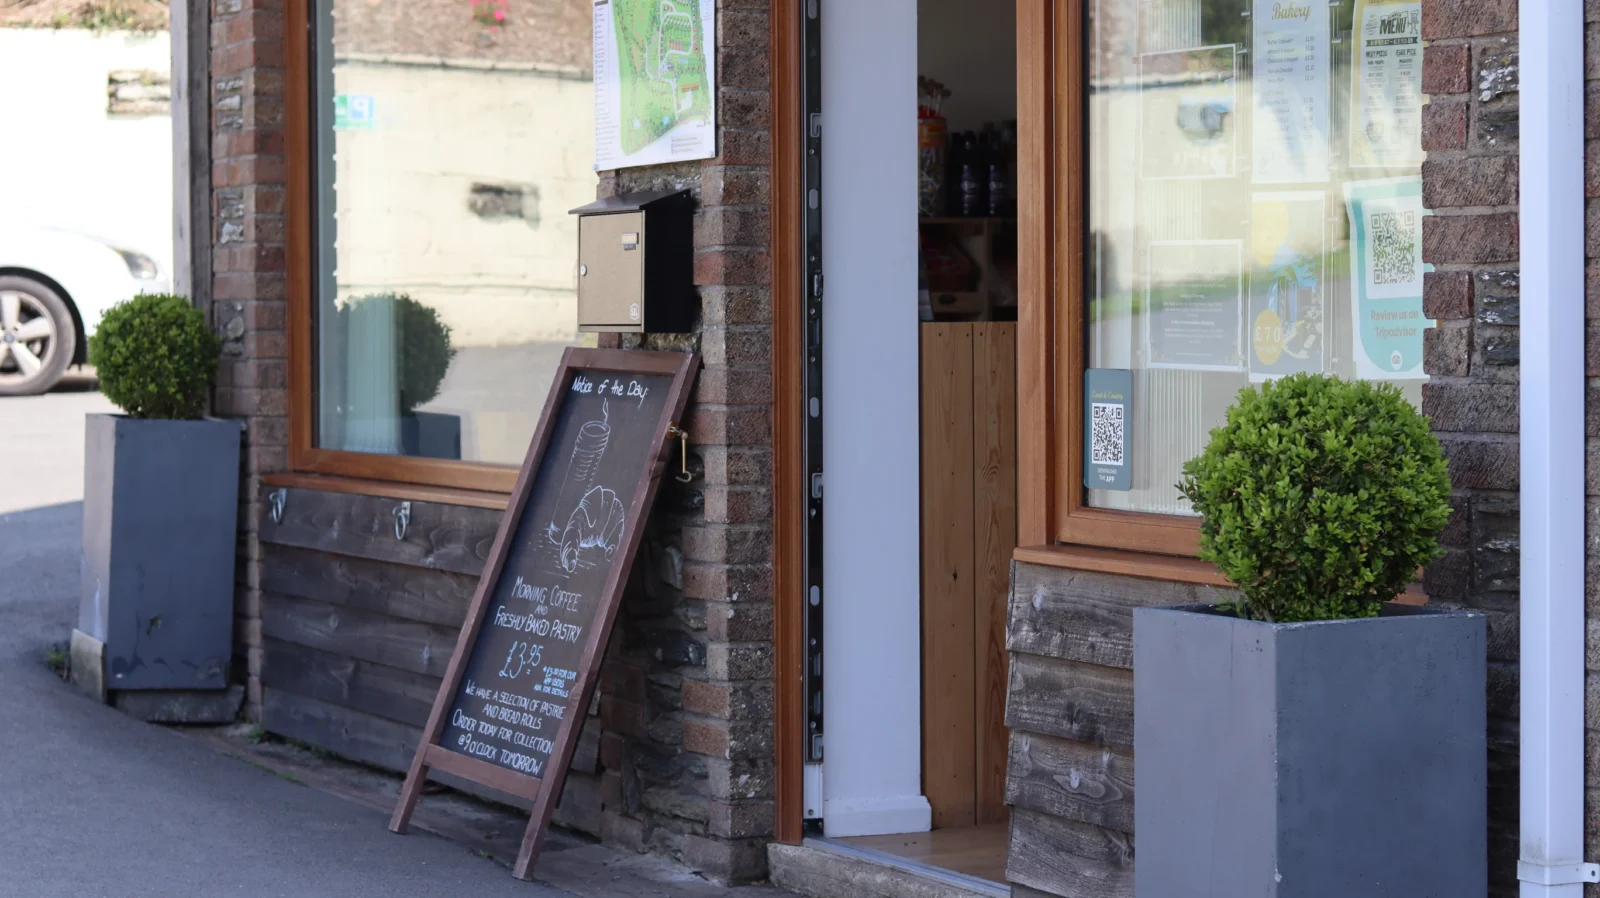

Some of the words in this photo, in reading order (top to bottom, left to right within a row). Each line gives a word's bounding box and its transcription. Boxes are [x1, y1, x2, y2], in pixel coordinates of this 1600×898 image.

[1272, 2, 1311, 23] Bakery
[1379, 17, 1407, 35] MENU
[1370, 309, 1397, 320] Review
[1399, 311, 1407, 320] us
[1408, 310, 1419, 319] on
[1375, 326, 1417, 340] Tripadvisor
[572, 376, 593, 393] Notice
[598, 379, 609, 395] of
[611, 380, 624, 396] the
[1105, 475, 1115, 483] APP
[534, 604, 548, 615] AND
[494, 605, 527, 631] FRESHLY
[525, 614, 550, 636] BAKED
[550, 619, 583, 643] PASTRY
[498, 641, 544, 679] £3.95
[465, 679, 475, 696] WE
[475, 687, 492, 700] HAVE
[492, 690, 498, 703] A
[499, 691, 529, 710] SELECTION
[529, 699, 540, 712] OF
[551, 687, 569, 698] DETAILS
[482, 703, 499, 719] AND
[498, 707, 520, 724] BREAD
[521, 712, 542, 730] ROLLS
[452, 708, 477, 731] ORDER
[478, 721, 498, 737] TODAY
[498, 727, 512, 742] FOR
[513, 731, 555, 755] COLLECTION
[500, 748, 543, 775] TOMORROW
